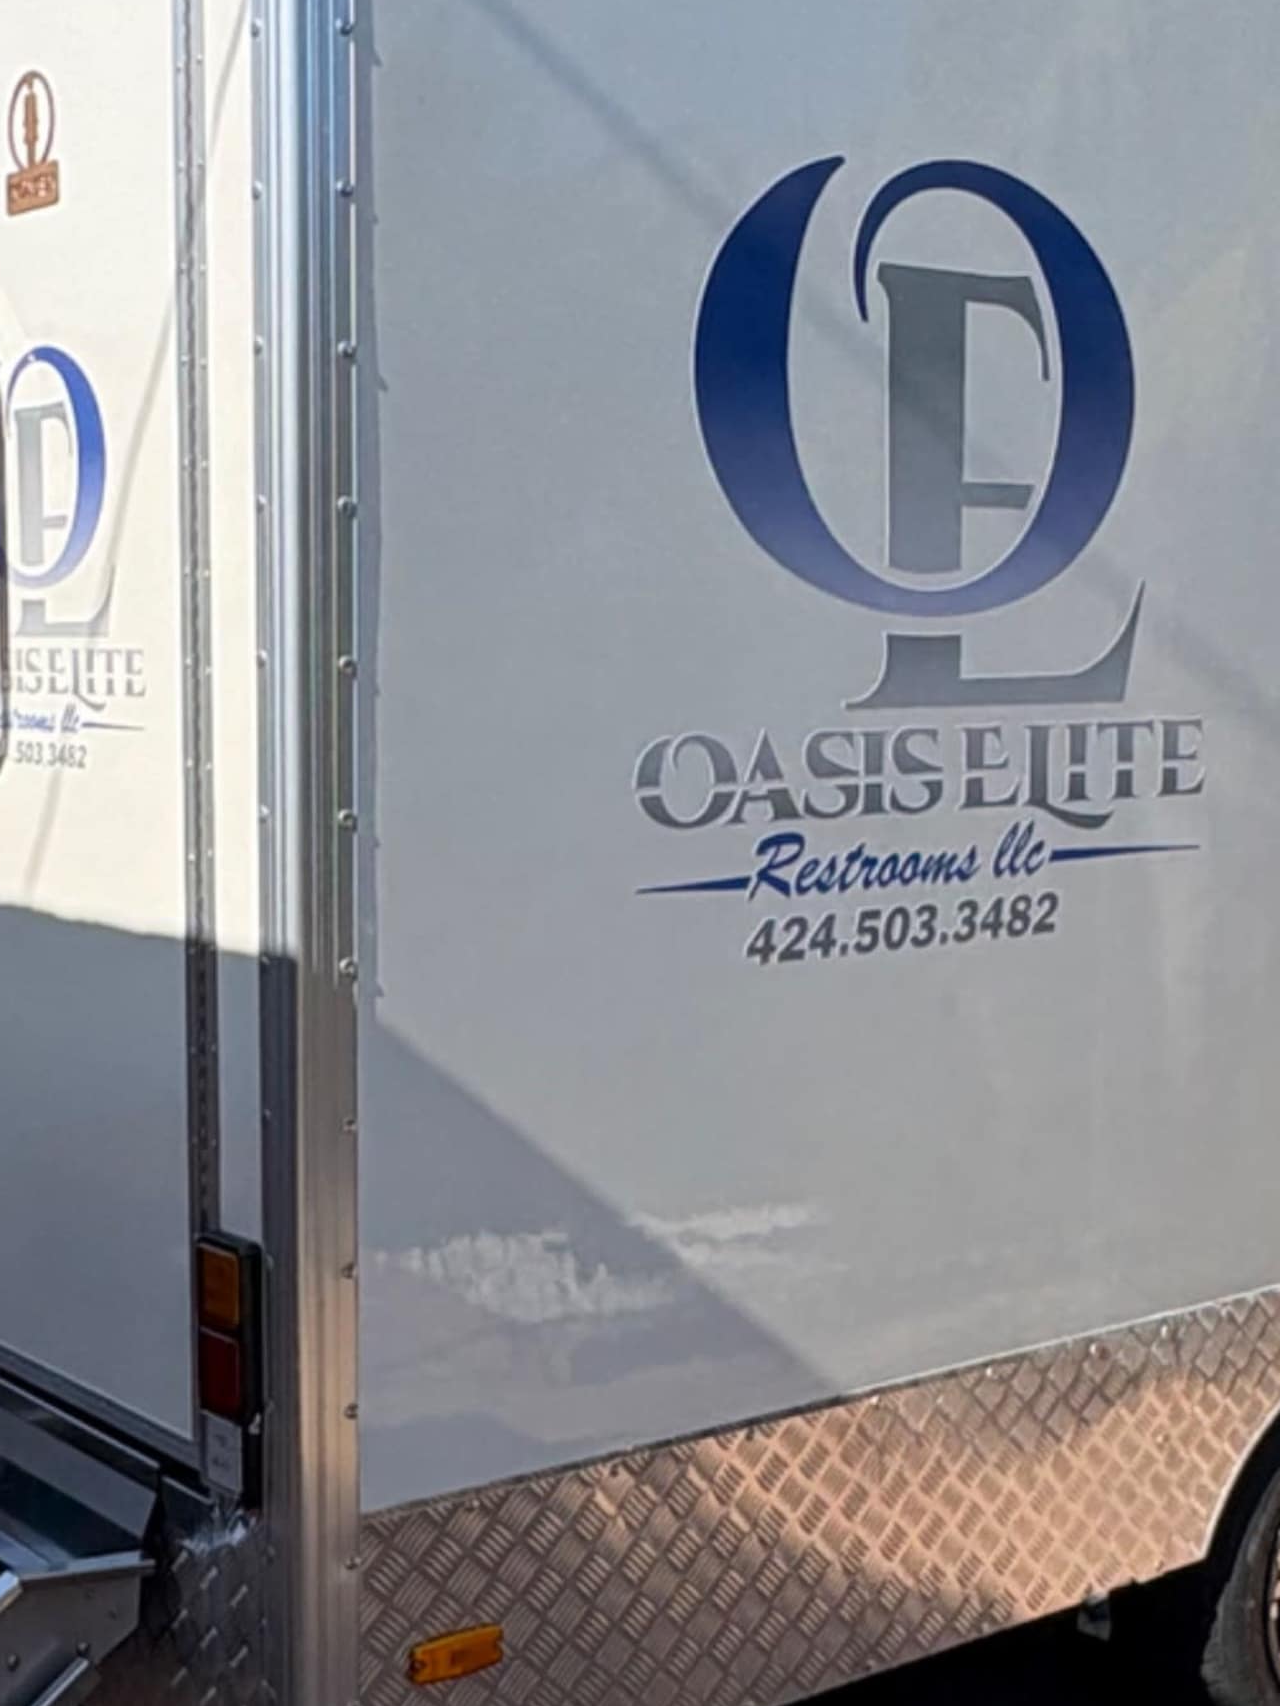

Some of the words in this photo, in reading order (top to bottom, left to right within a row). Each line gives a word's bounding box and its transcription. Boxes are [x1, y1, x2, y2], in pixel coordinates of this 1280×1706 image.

[634, 727, 944, 830] OASIS
[959, 717, 1207, 830] ELITE
[748, 831, 982, 901] Restrooms
[992, 820, 1045, 880] llc
[746, 892, 1059, 966] 424.503.3482
